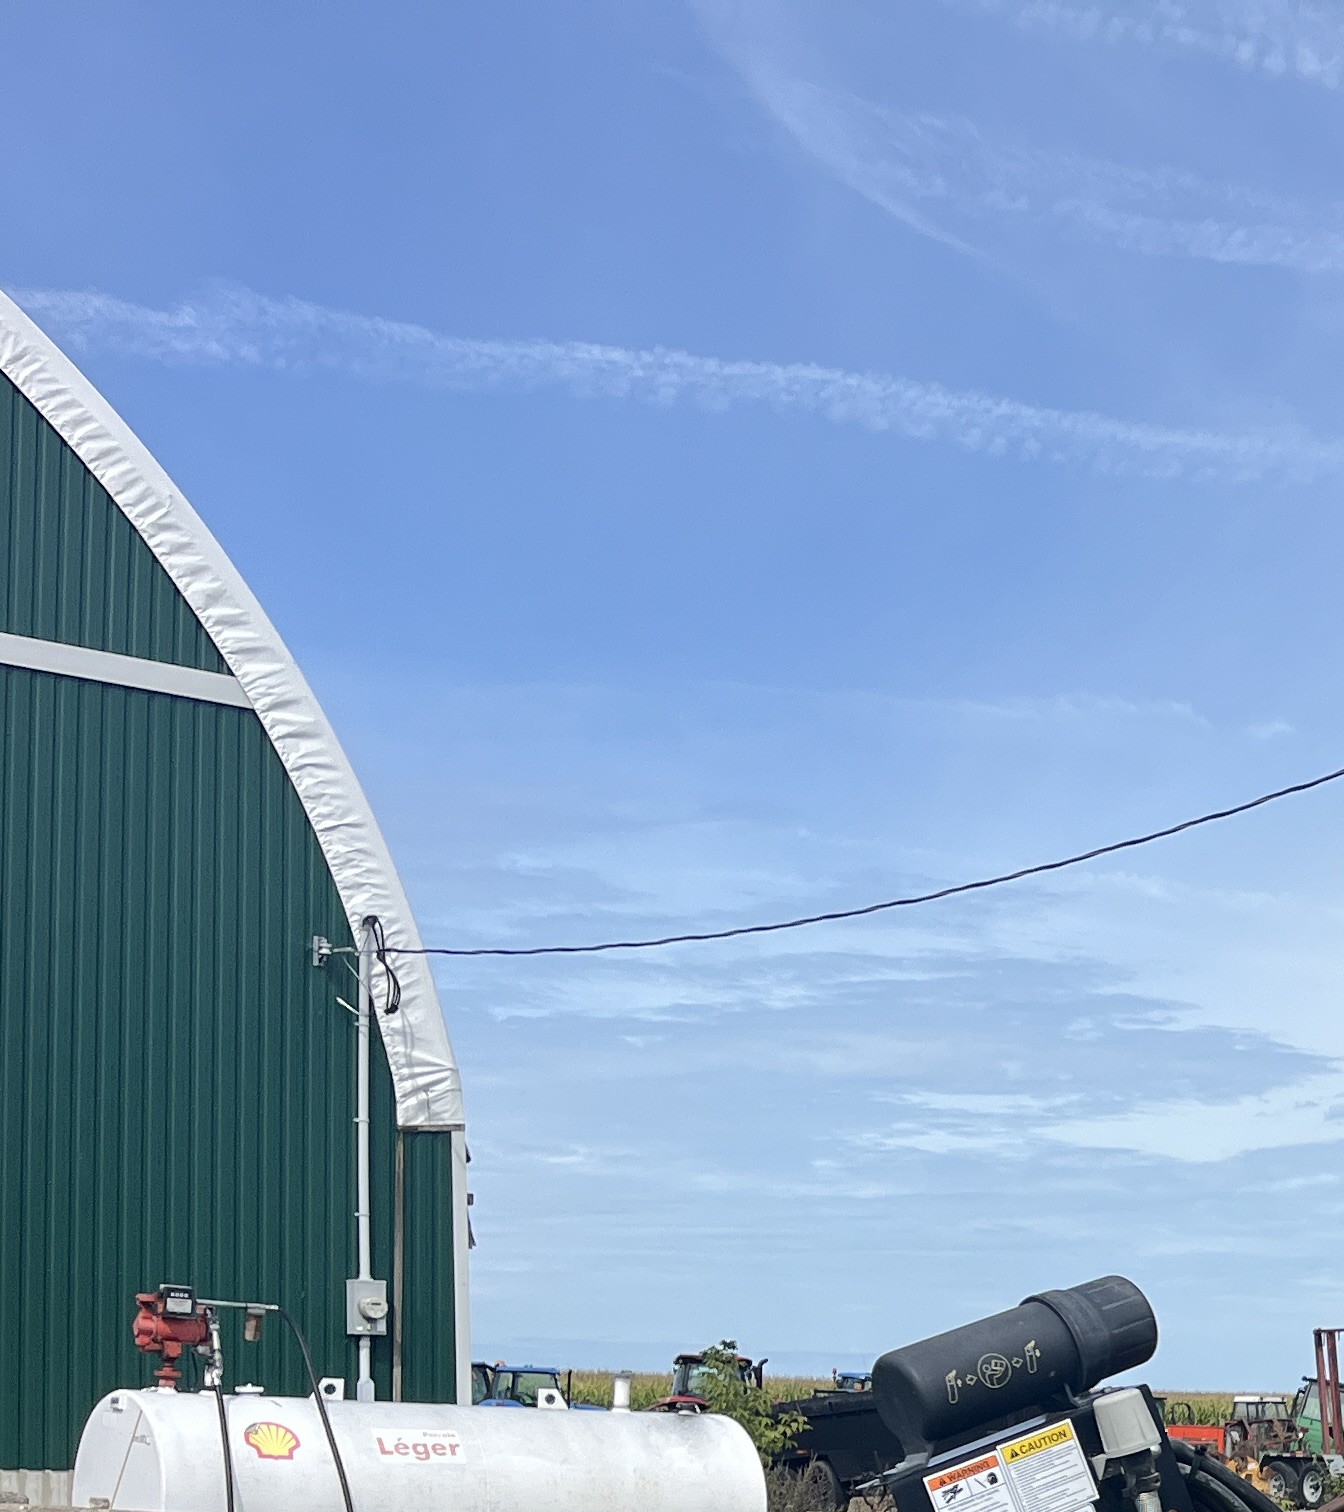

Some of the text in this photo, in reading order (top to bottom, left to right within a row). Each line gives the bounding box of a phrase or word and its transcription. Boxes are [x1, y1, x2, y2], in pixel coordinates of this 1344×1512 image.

[375, 1436, 460, 1461] Léger
[1018, 1428, 1068, 1456] CAUTION
[946, 1459, 991, 1483] WARNING
